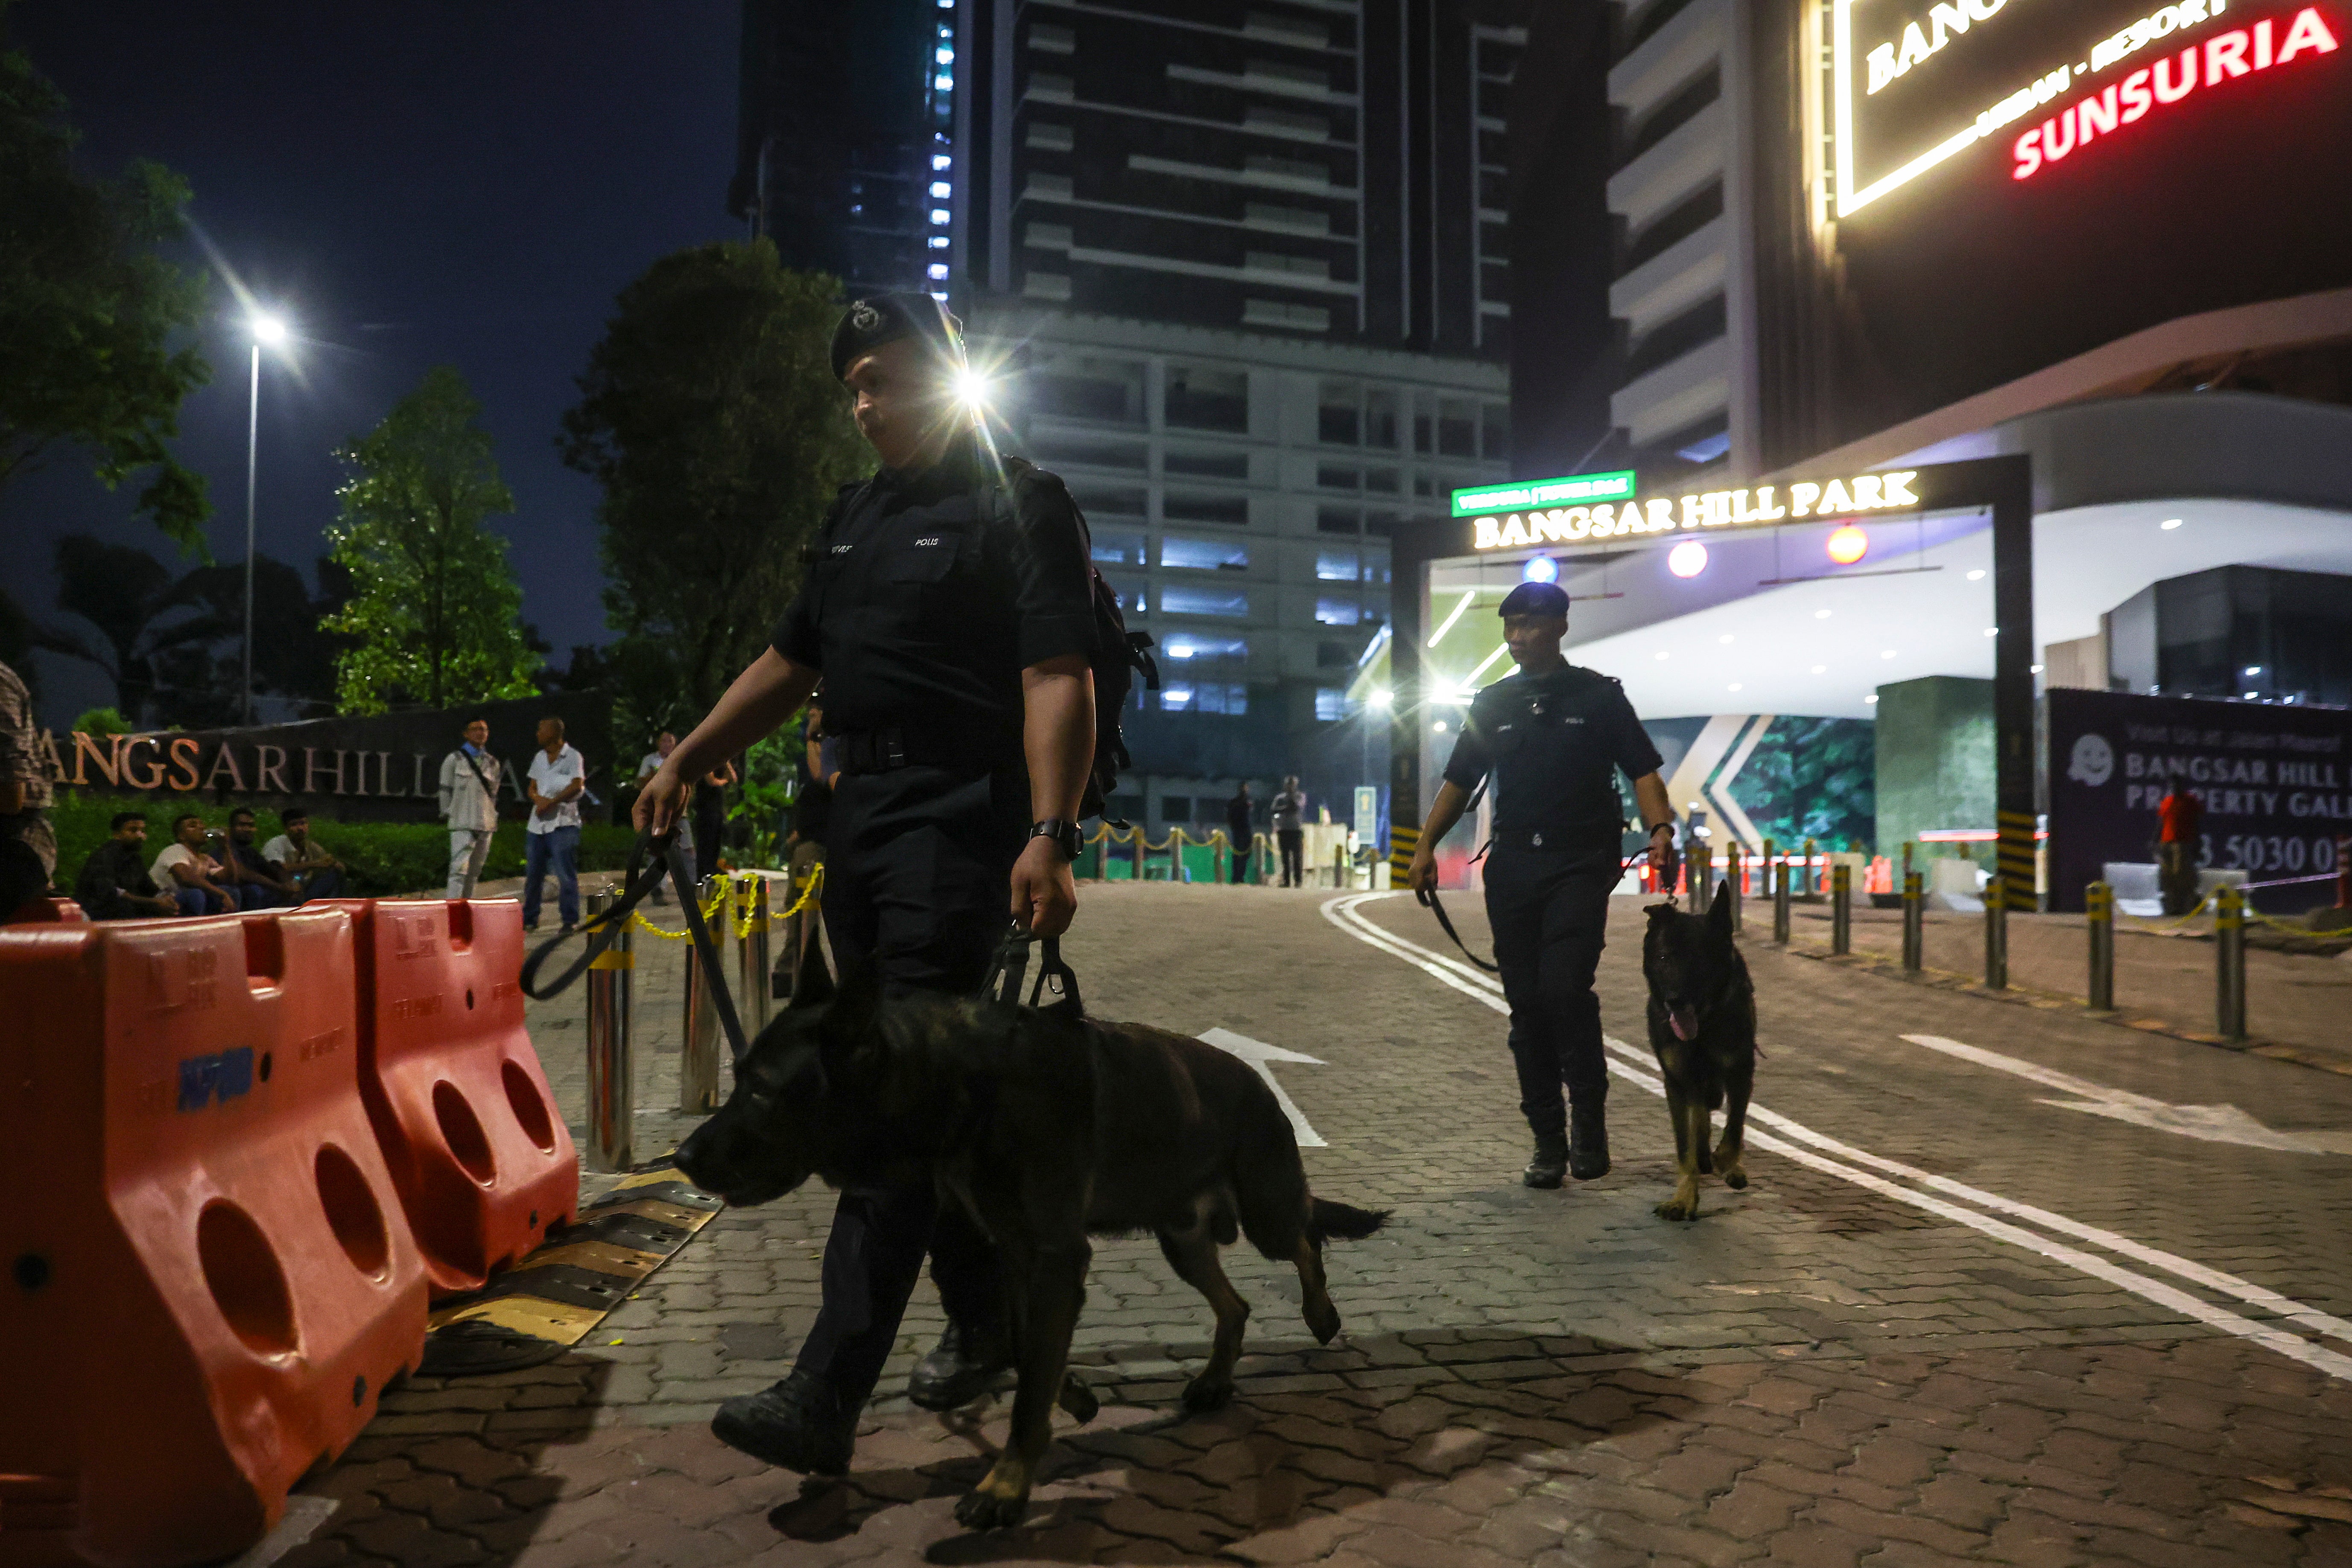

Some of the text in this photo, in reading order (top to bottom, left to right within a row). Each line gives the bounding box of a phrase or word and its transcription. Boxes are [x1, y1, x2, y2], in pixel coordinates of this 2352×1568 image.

[2011, 7, 2338, 180] SUNSURIA
[1474, 471, 1918, 549] BANGSAR HILL PARK
[915, 538, 939, 546] POLIS
[41, 727, 291, 793] ANGSAR
[304, 746, 441, 798] HILL
[2125, 753, 2268, 784] BANGSAR
[2277, 760, 2339, 788] HILL
[2224, 834, 2306, 872] 5030
